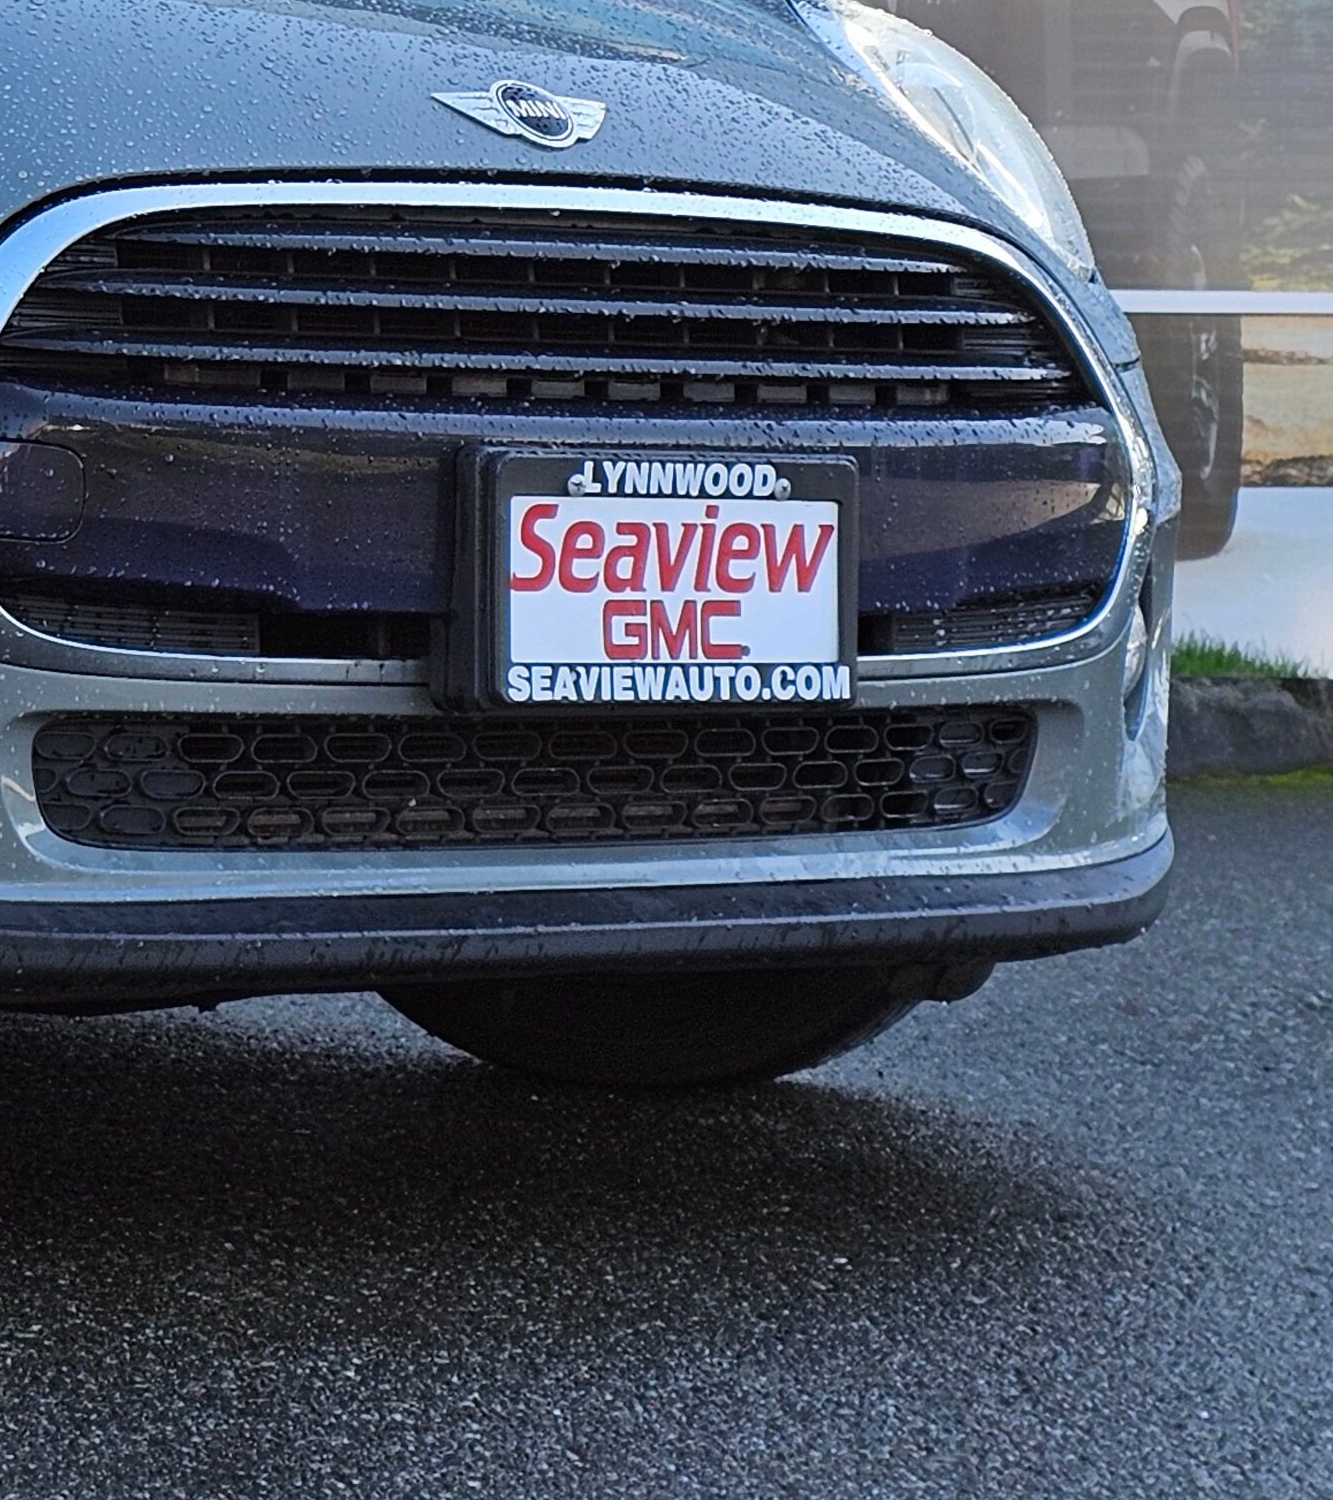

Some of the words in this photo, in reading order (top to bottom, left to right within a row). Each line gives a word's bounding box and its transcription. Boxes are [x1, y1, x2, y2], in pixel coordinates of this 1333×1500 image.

[506, 99, 567, 120] MINI
[583, 460, 777, 497] LYNNWOOD
[510, 503, 835, 594] Seaview
[602, 599, 743, 660] GMC
[507, 663, 851, 701] SEAVIEWAUTO.COM
